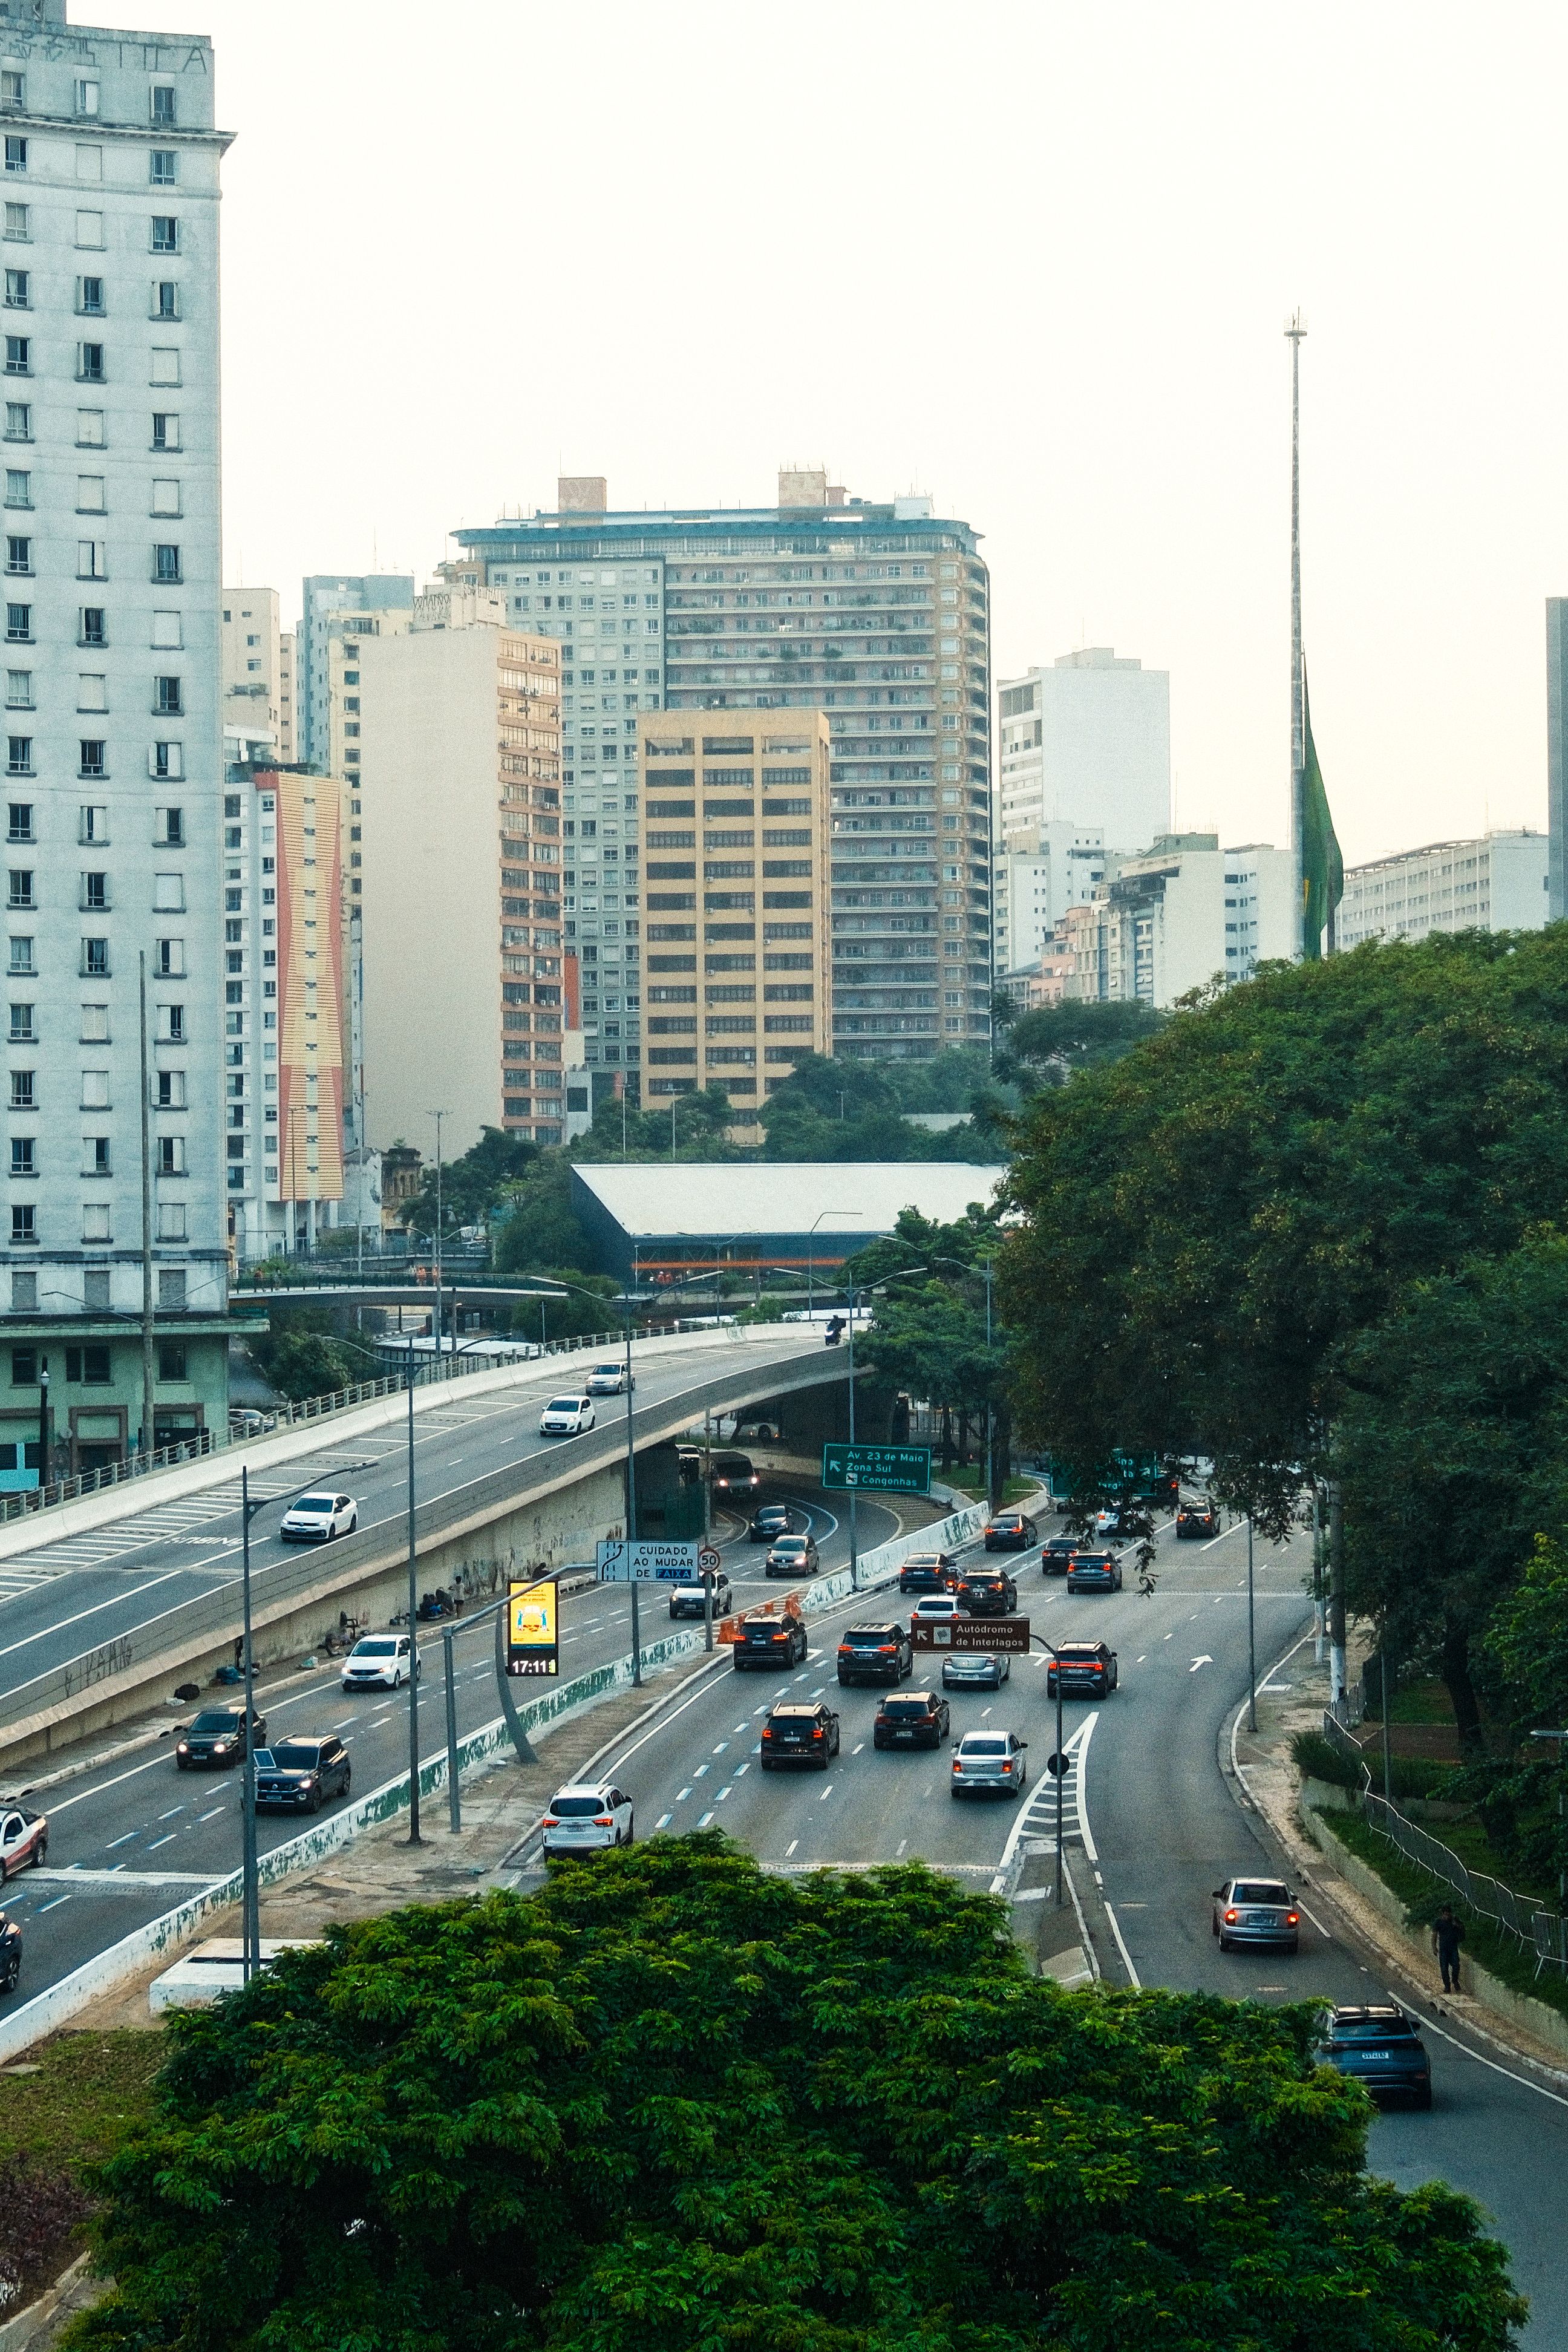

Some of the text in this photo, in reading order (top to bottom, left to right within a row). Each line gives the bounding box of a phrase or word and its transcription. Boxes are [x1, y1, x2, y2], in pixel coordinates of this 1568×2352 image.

[867, 1451, 880, 1460] 23
[884, 1452, 896, 1461] de
[900, 1453, 924, 1462] Maio
[847, 1463, 891, 1472] Zona Sul
[862, 1475, 917, 1487] Congonhas
[639, 1546, 688, 1555] CUIDADO
[655, 1558, 693, 1566] MUDAR
[701, 1555, 716, 1566] 50
[636, 1569, 691, 1578] DE FAIXA
[956, 1625, 1013, 1634] Autódromo
[956, 1638, 1024, 1648] de Interlagos
[512, 1660, 546, 1673] 17:11
